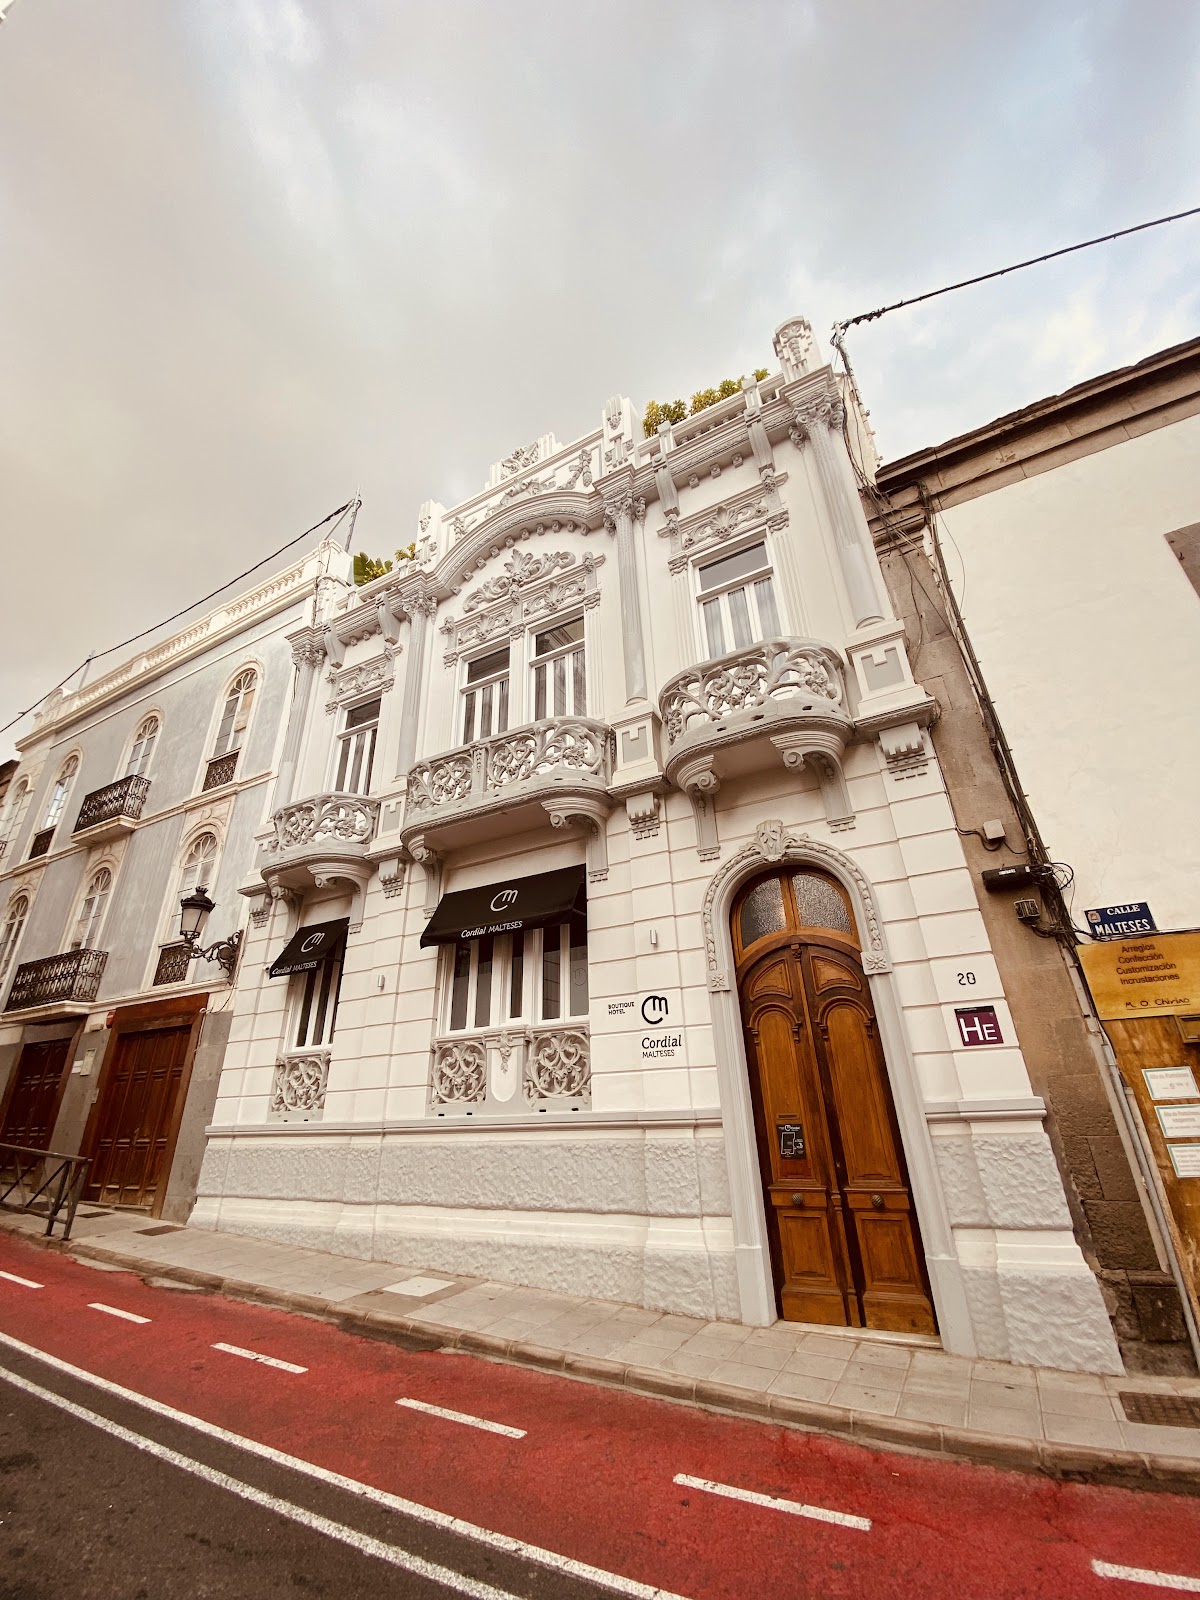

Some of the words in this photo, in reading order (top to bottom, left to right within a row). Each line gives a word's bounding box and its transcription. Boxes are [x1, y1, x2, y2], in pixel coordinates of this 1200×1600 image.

[1106, 904, 1140, 916] CALLE
[461, 926, 487, 938] Cordial
[488, 920, 523, 934] MALTESES
[1094, 919, 1151, 936] MALTESES
[1122, 944, 1156, 953] Arreglos
[1116, 962, 1177, 975] Customización
[957, 972, 976, 985] 20
[1120, 973, 1180, 985] Incrustaciones
[608, 1001, 635, 1010] BOUTIQUE
[608, 1008, 626, 1016] HOTEL
[641, 1034, 682, 1050] Cordial
[642, 1049, 675, 1059] MALTESES
